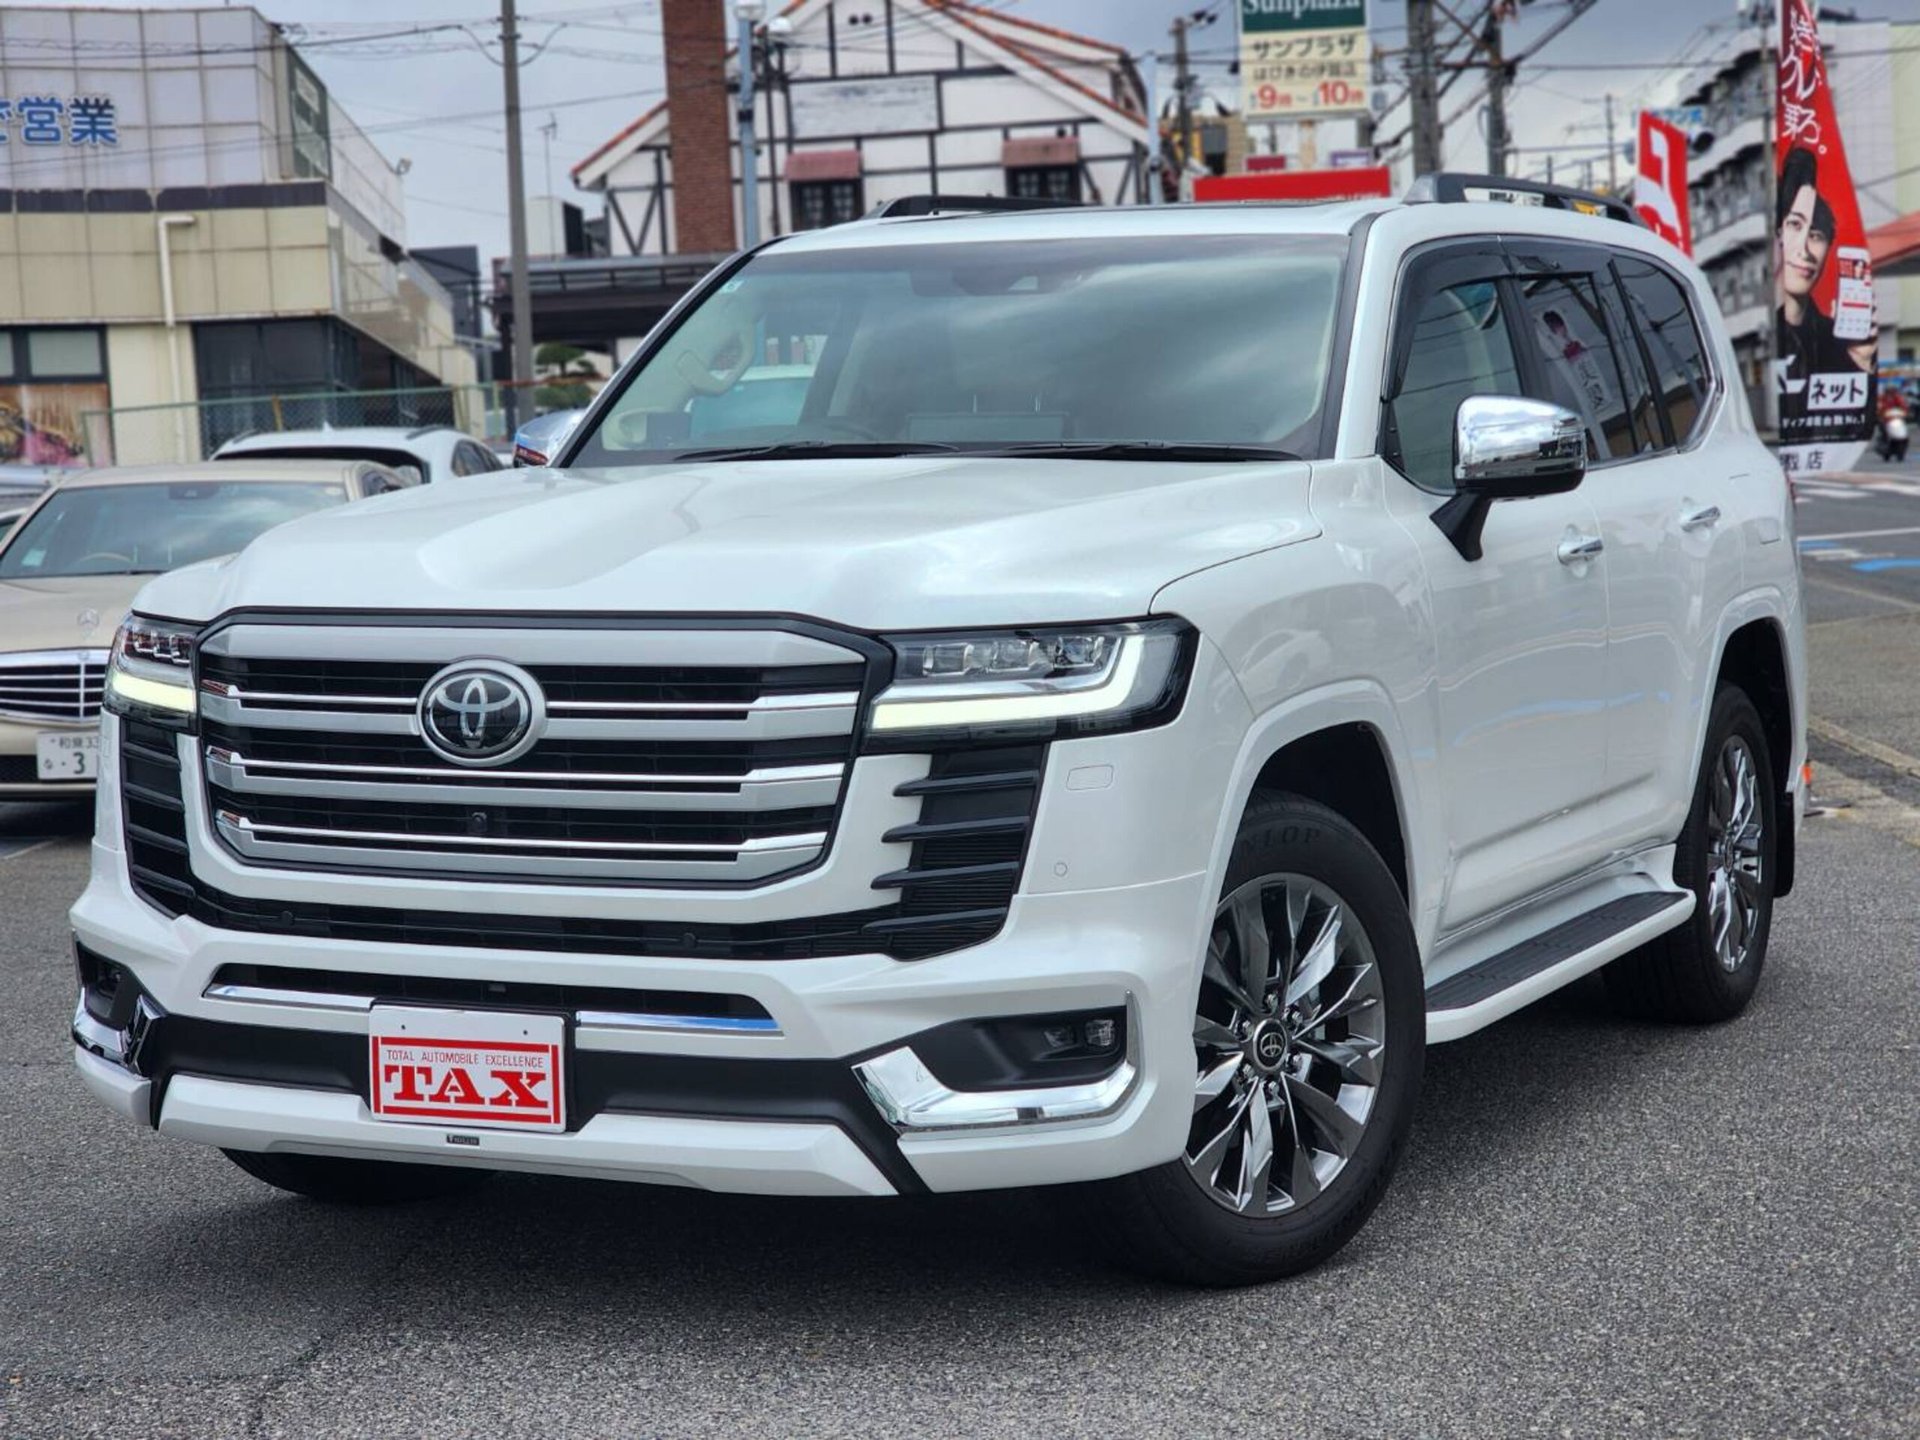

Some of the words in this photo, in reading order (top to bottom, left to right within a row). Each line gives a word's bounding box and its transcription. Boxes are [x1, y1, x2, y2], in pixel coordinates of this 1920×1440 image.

[1252, 34, 1356, 59] サンプラザ
[0, 97, 117, 143] 営業
[1810, 378, 1864, 405] ネット
[387, 1050, 415, 1062] TOTAL
[421, 1053, 479, 1065] AUTOMOBILE
[485, 1055, 544, 1068] EXCELLENCE
[384, 1065, 548, 1109] TAX
